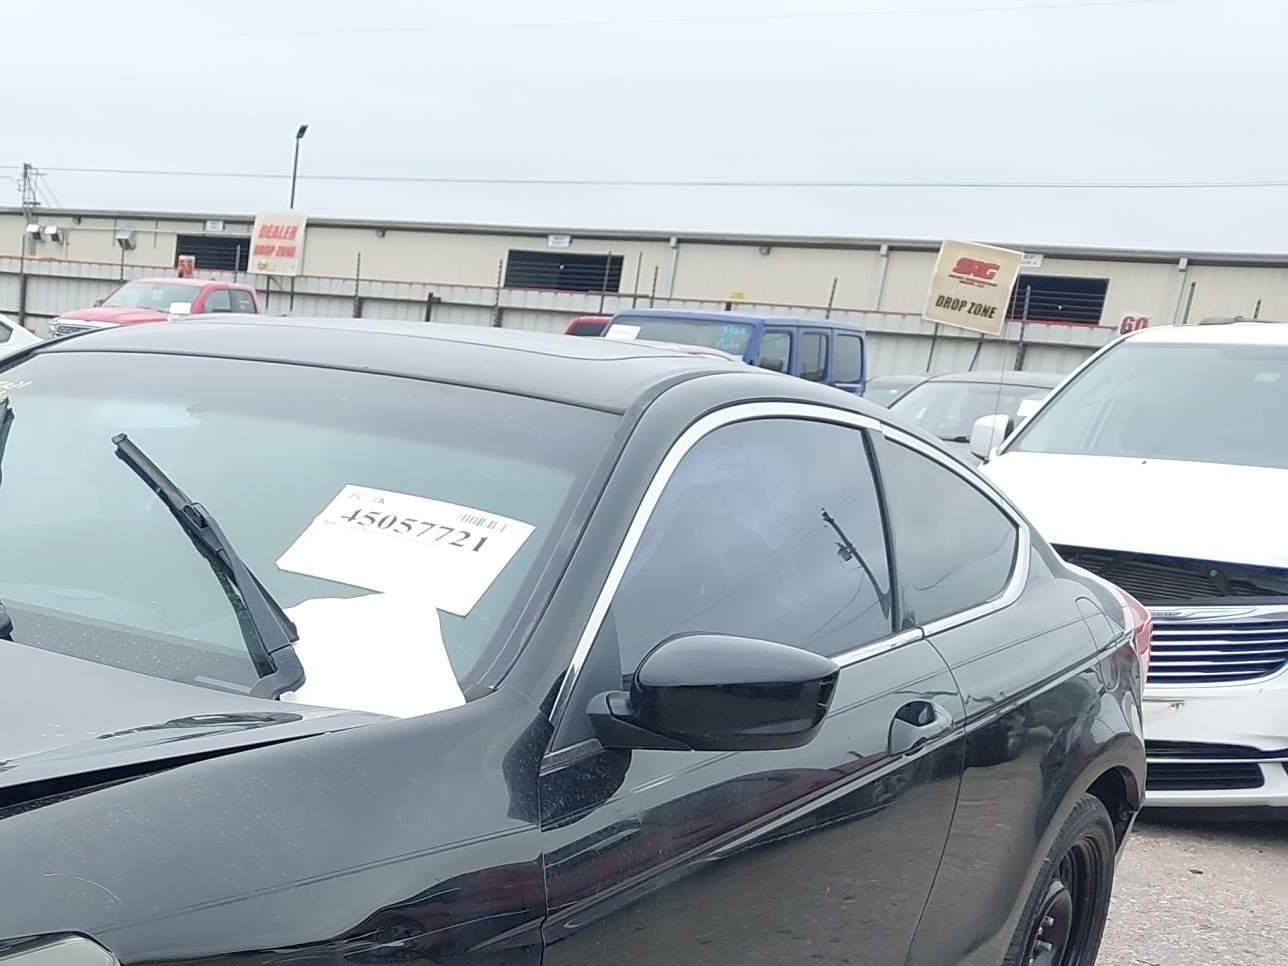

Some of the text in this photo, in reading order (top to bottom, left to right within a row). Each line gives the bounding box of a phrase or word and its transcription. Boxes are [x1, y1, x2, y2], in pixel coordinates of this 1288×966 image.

[258, 224, 298, 240] DEALER
[253, 244, 297, 258] DROP ZONE
[935, 295, 997, 319] DROP ZONE
[340, 507, 488, 553] 45057721
